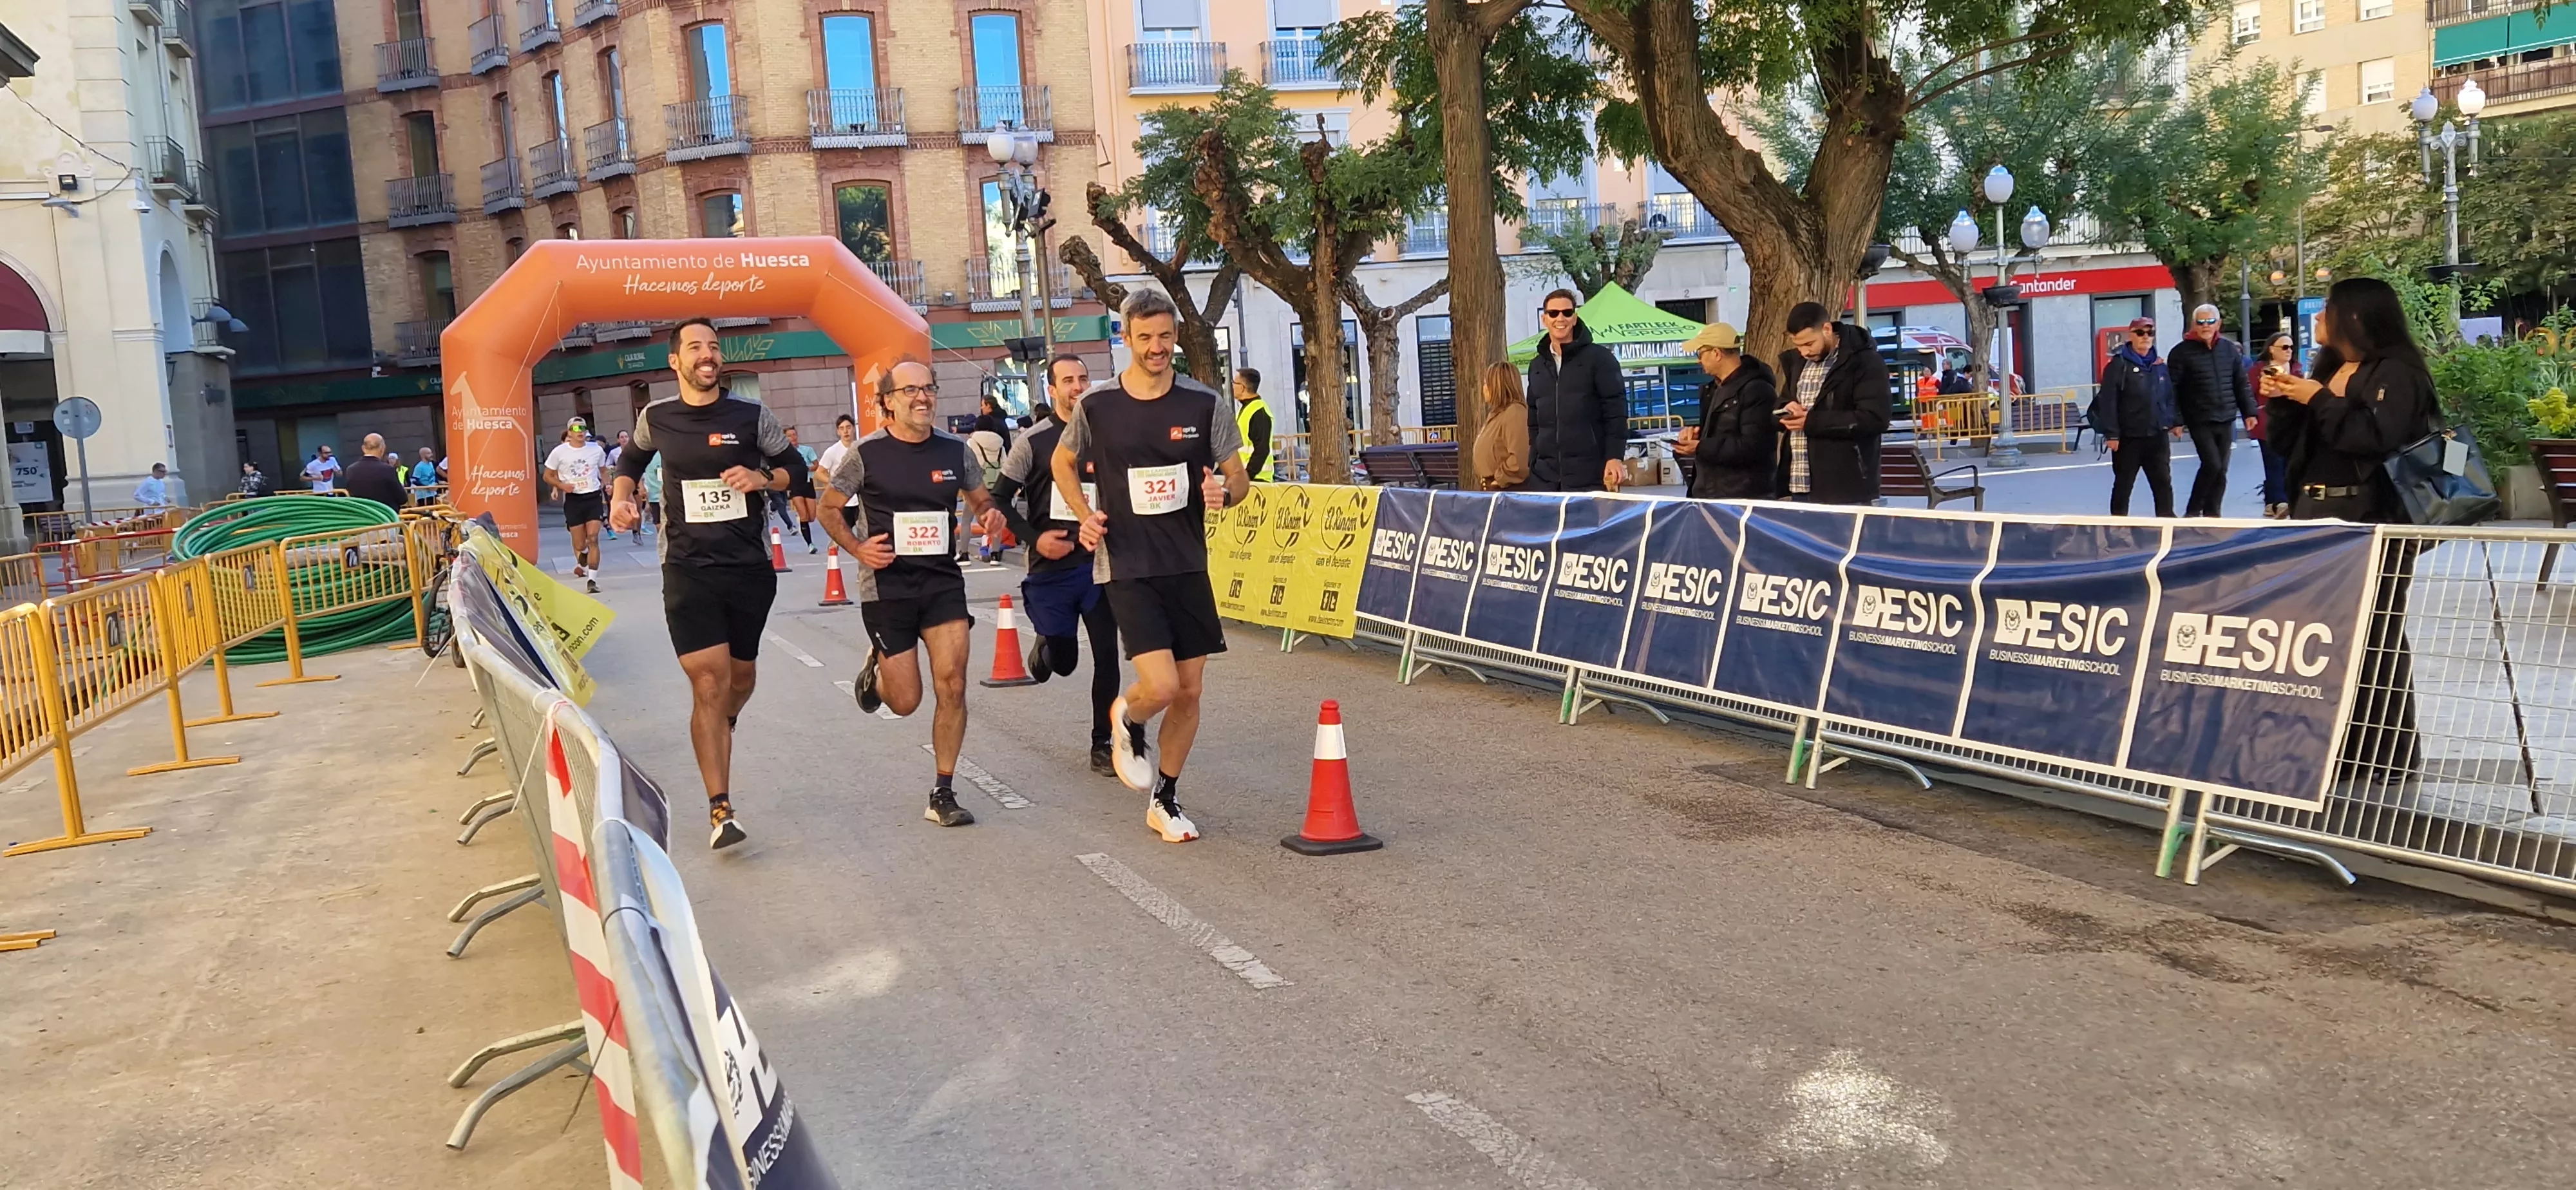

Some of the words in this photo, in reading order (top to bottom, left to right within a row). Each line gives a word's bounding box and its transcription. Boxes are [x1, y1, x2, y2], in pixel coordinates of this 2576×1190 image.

[576, 254, 708, 274] Ayuntamiento
[713, 253, 735, 267] de
[740, 252, 810, 268] Huesca
[623, 274, 698, 295] Hacemos
[702, 272, 766, 300] deporte
[1684, 289, 1690, 298] 2
[1618, 321, 1680, 330] FARTLECK
[1622, 342, 1698, 359] AVITUALLAMIE
[451, 405, 527, 420] Ayuntamiento
[453, 420, 464, 430] de
[466, 419, 513, 430] Huesca
[470, 465, 526, 482] Hacemos
[471, 480, 520, 502] deporte
[698, 489, 732, 504] 135
[1144, 478, 1177, 495] 321
[1148, 494, 1176, 502] JAVIER
[908, 526, 940, 539] 322
[1383, 530, 1416, 561] ESIC
[1435, 538, 1474, 571] ESIC
[1500, 544, 1544, 581] ESIC
[1574, 554, 1629, 594] ESIC
[1663, 564, 1723, 606] ESIC
[1761, 575, 1831, 621] ESIC
[1880, 588, 1964, 638] ESIC
[2026, 601, 2129, 656] ESIC
[1848, 631, 1958, 655] BUSINESS&MARKETINGSCHOOL
[2204, 615, 2333, 677] ESIC
[1989, 649, 2121, 676] BUSINESS&MARKETINGSCHOOL
[2160, 669, 2324, 700] BUSINESS&MARKETINGSCHOOL
